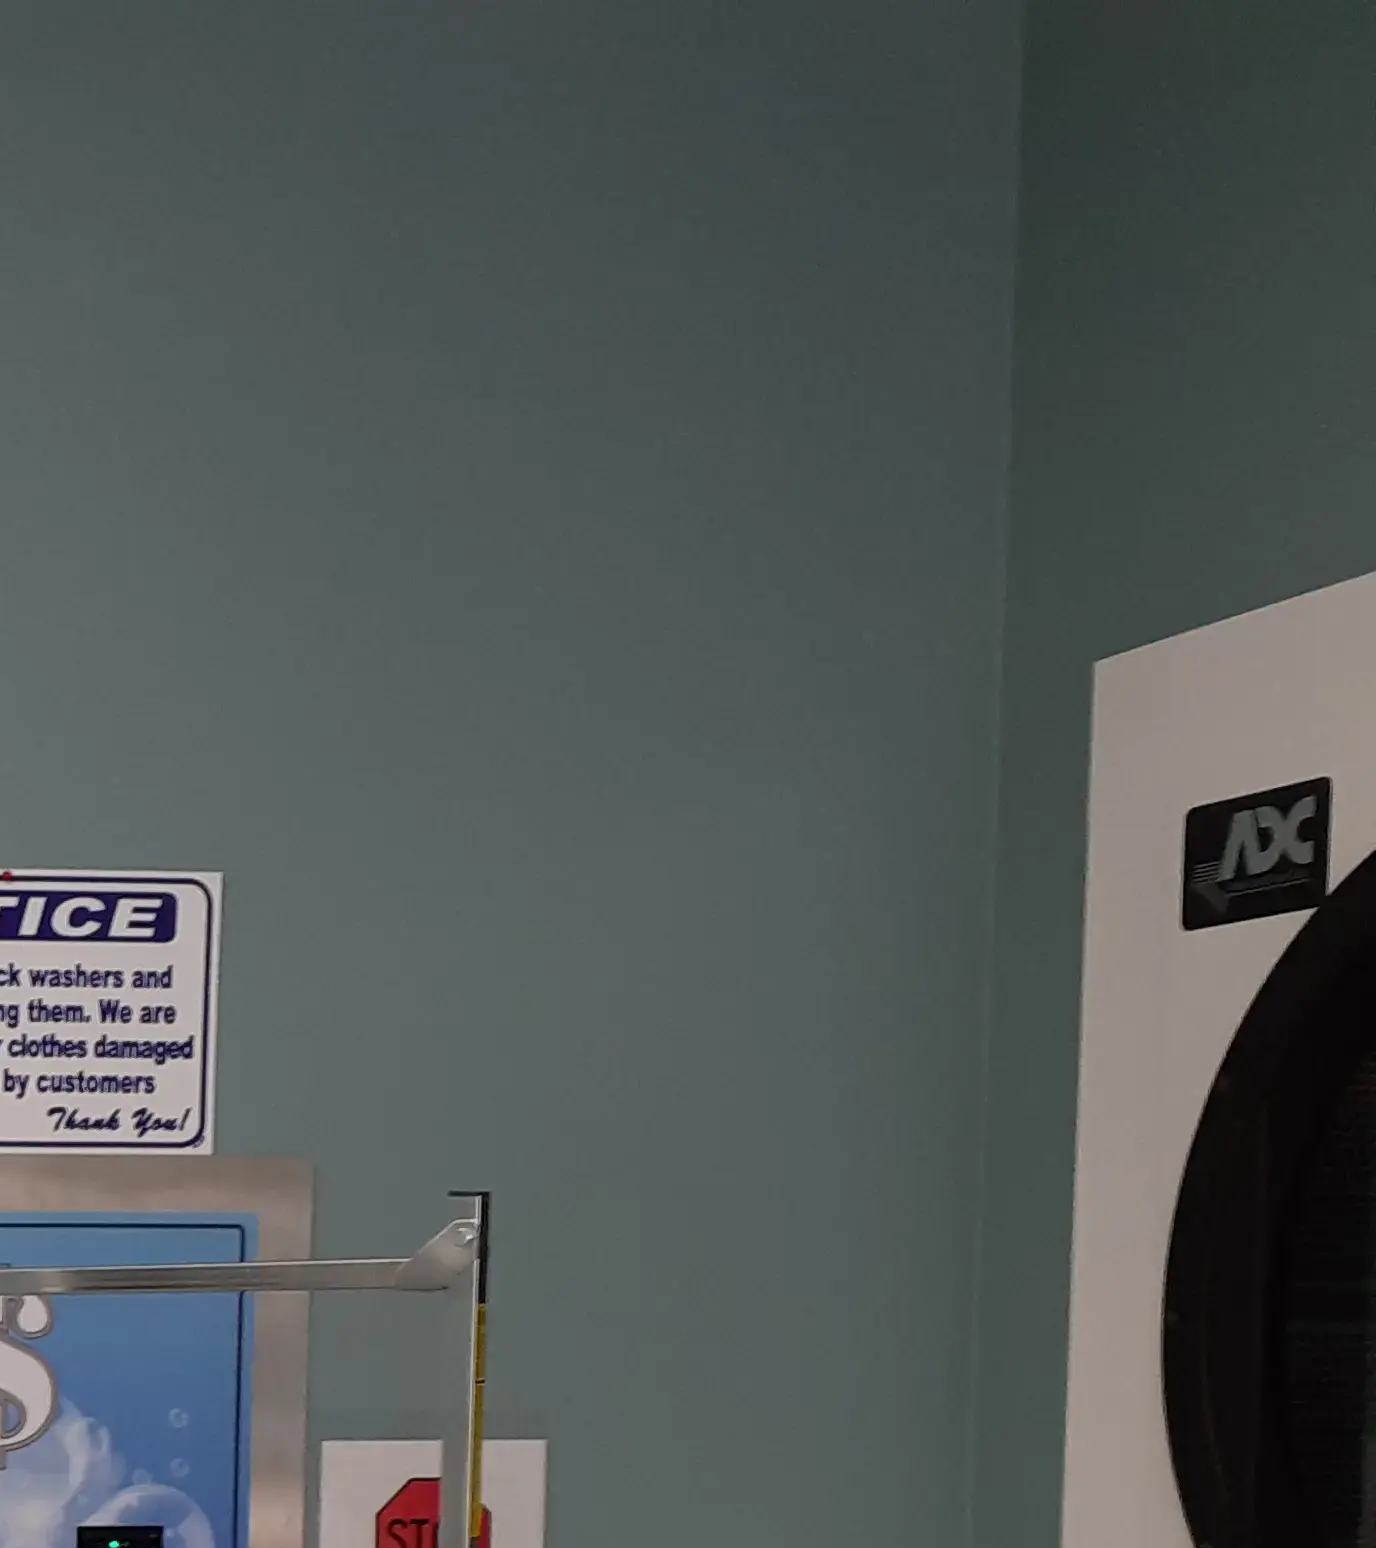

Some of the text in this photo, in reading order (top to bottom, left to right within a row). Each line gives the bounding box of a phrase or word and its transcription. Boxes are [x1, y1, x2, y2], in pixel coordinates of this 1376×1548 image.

[28, 963, 124, 989] washers
[131, 965, 174, 989] and
[27, 1000, 91, 1024] them.
[99, 1000, 132, 1024] We
[139, 1004, 176, 1025] are
[8, 1034, 87, 1059] clothes
[94, 1035, 195, 1065] damaged
[4, 1068, 28, 1098] by
[36, 1072, 156, 1095] customers
[48, 1106, 191, 1137] Thank You!
